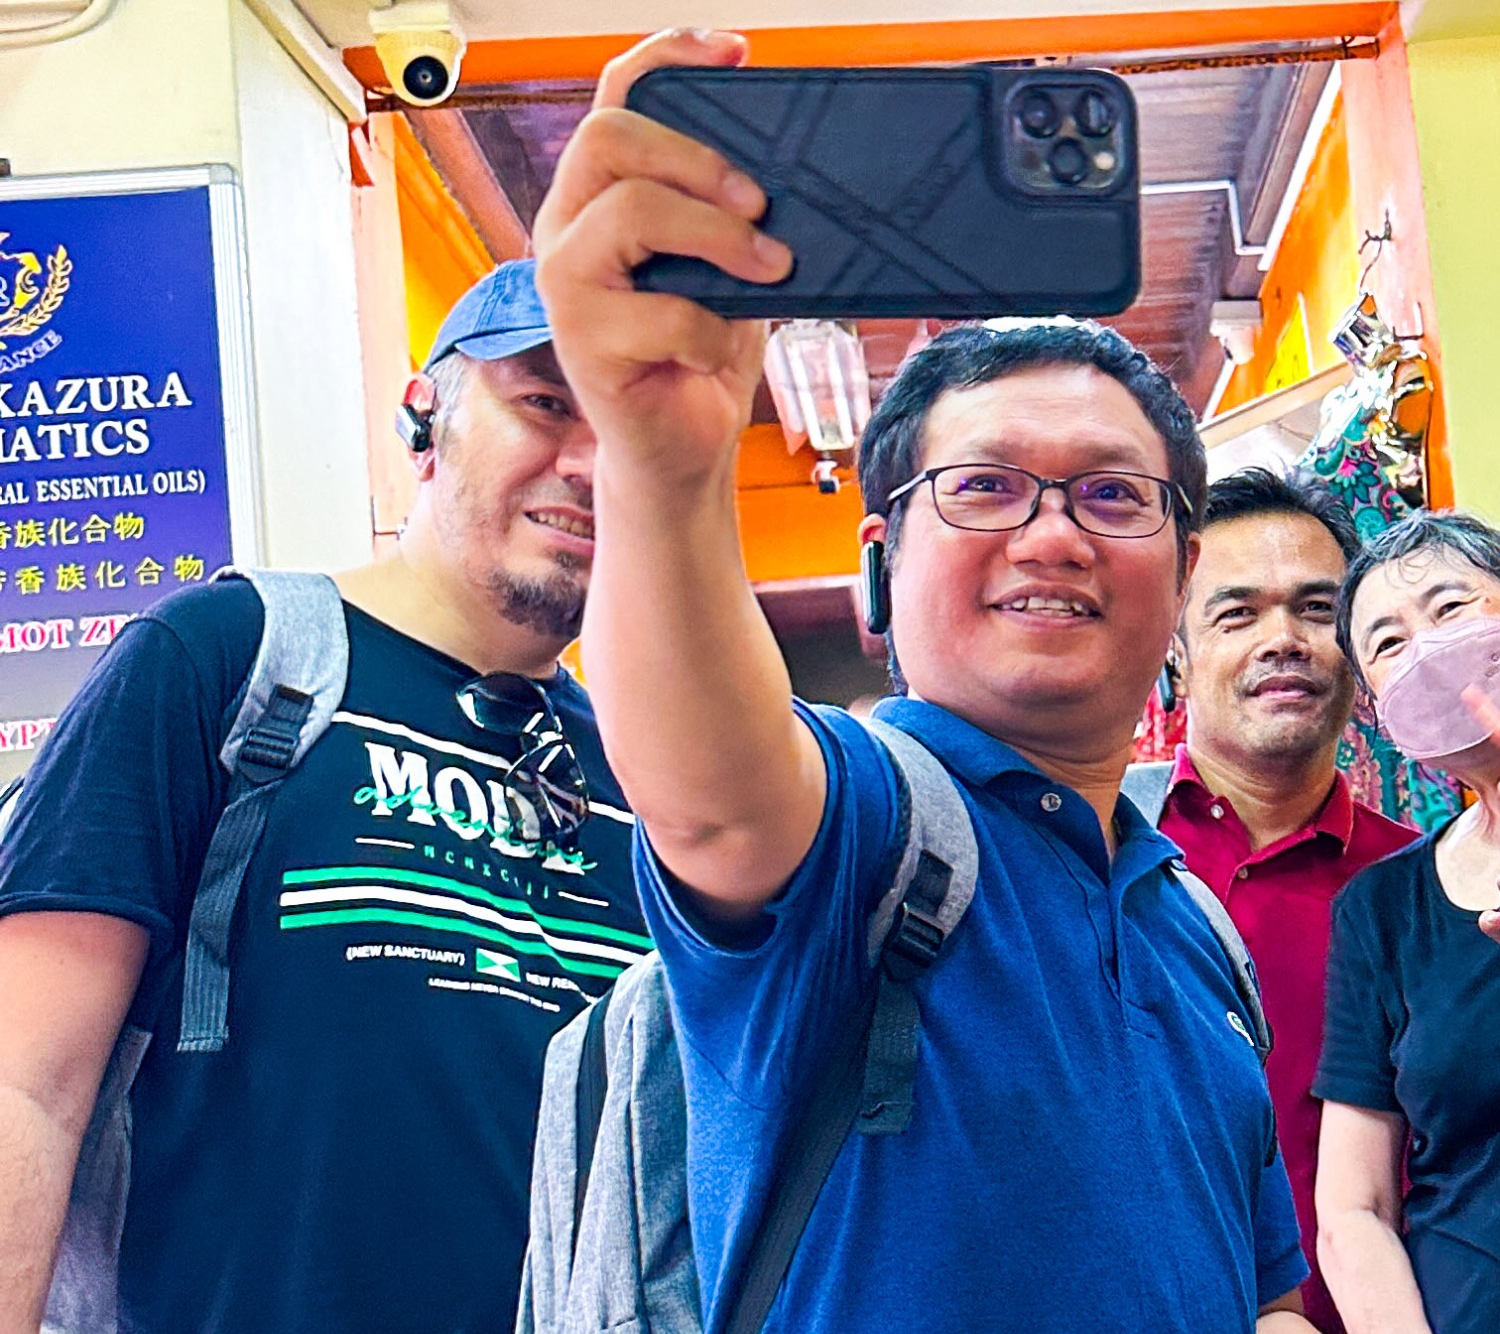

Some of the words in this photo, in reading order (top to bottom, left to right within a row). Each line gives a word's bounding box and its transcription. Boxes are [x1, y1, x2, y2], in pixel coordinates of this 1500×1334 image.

[0, 418, 151, 464] ATICS
[37, 473, 149, 503] ESSENTIAL
[152, 469, 207, 495] OILS)
[0, 554, 205, 596] 香族化合物
[384, 944, 466, 967] SANCTUARY)
